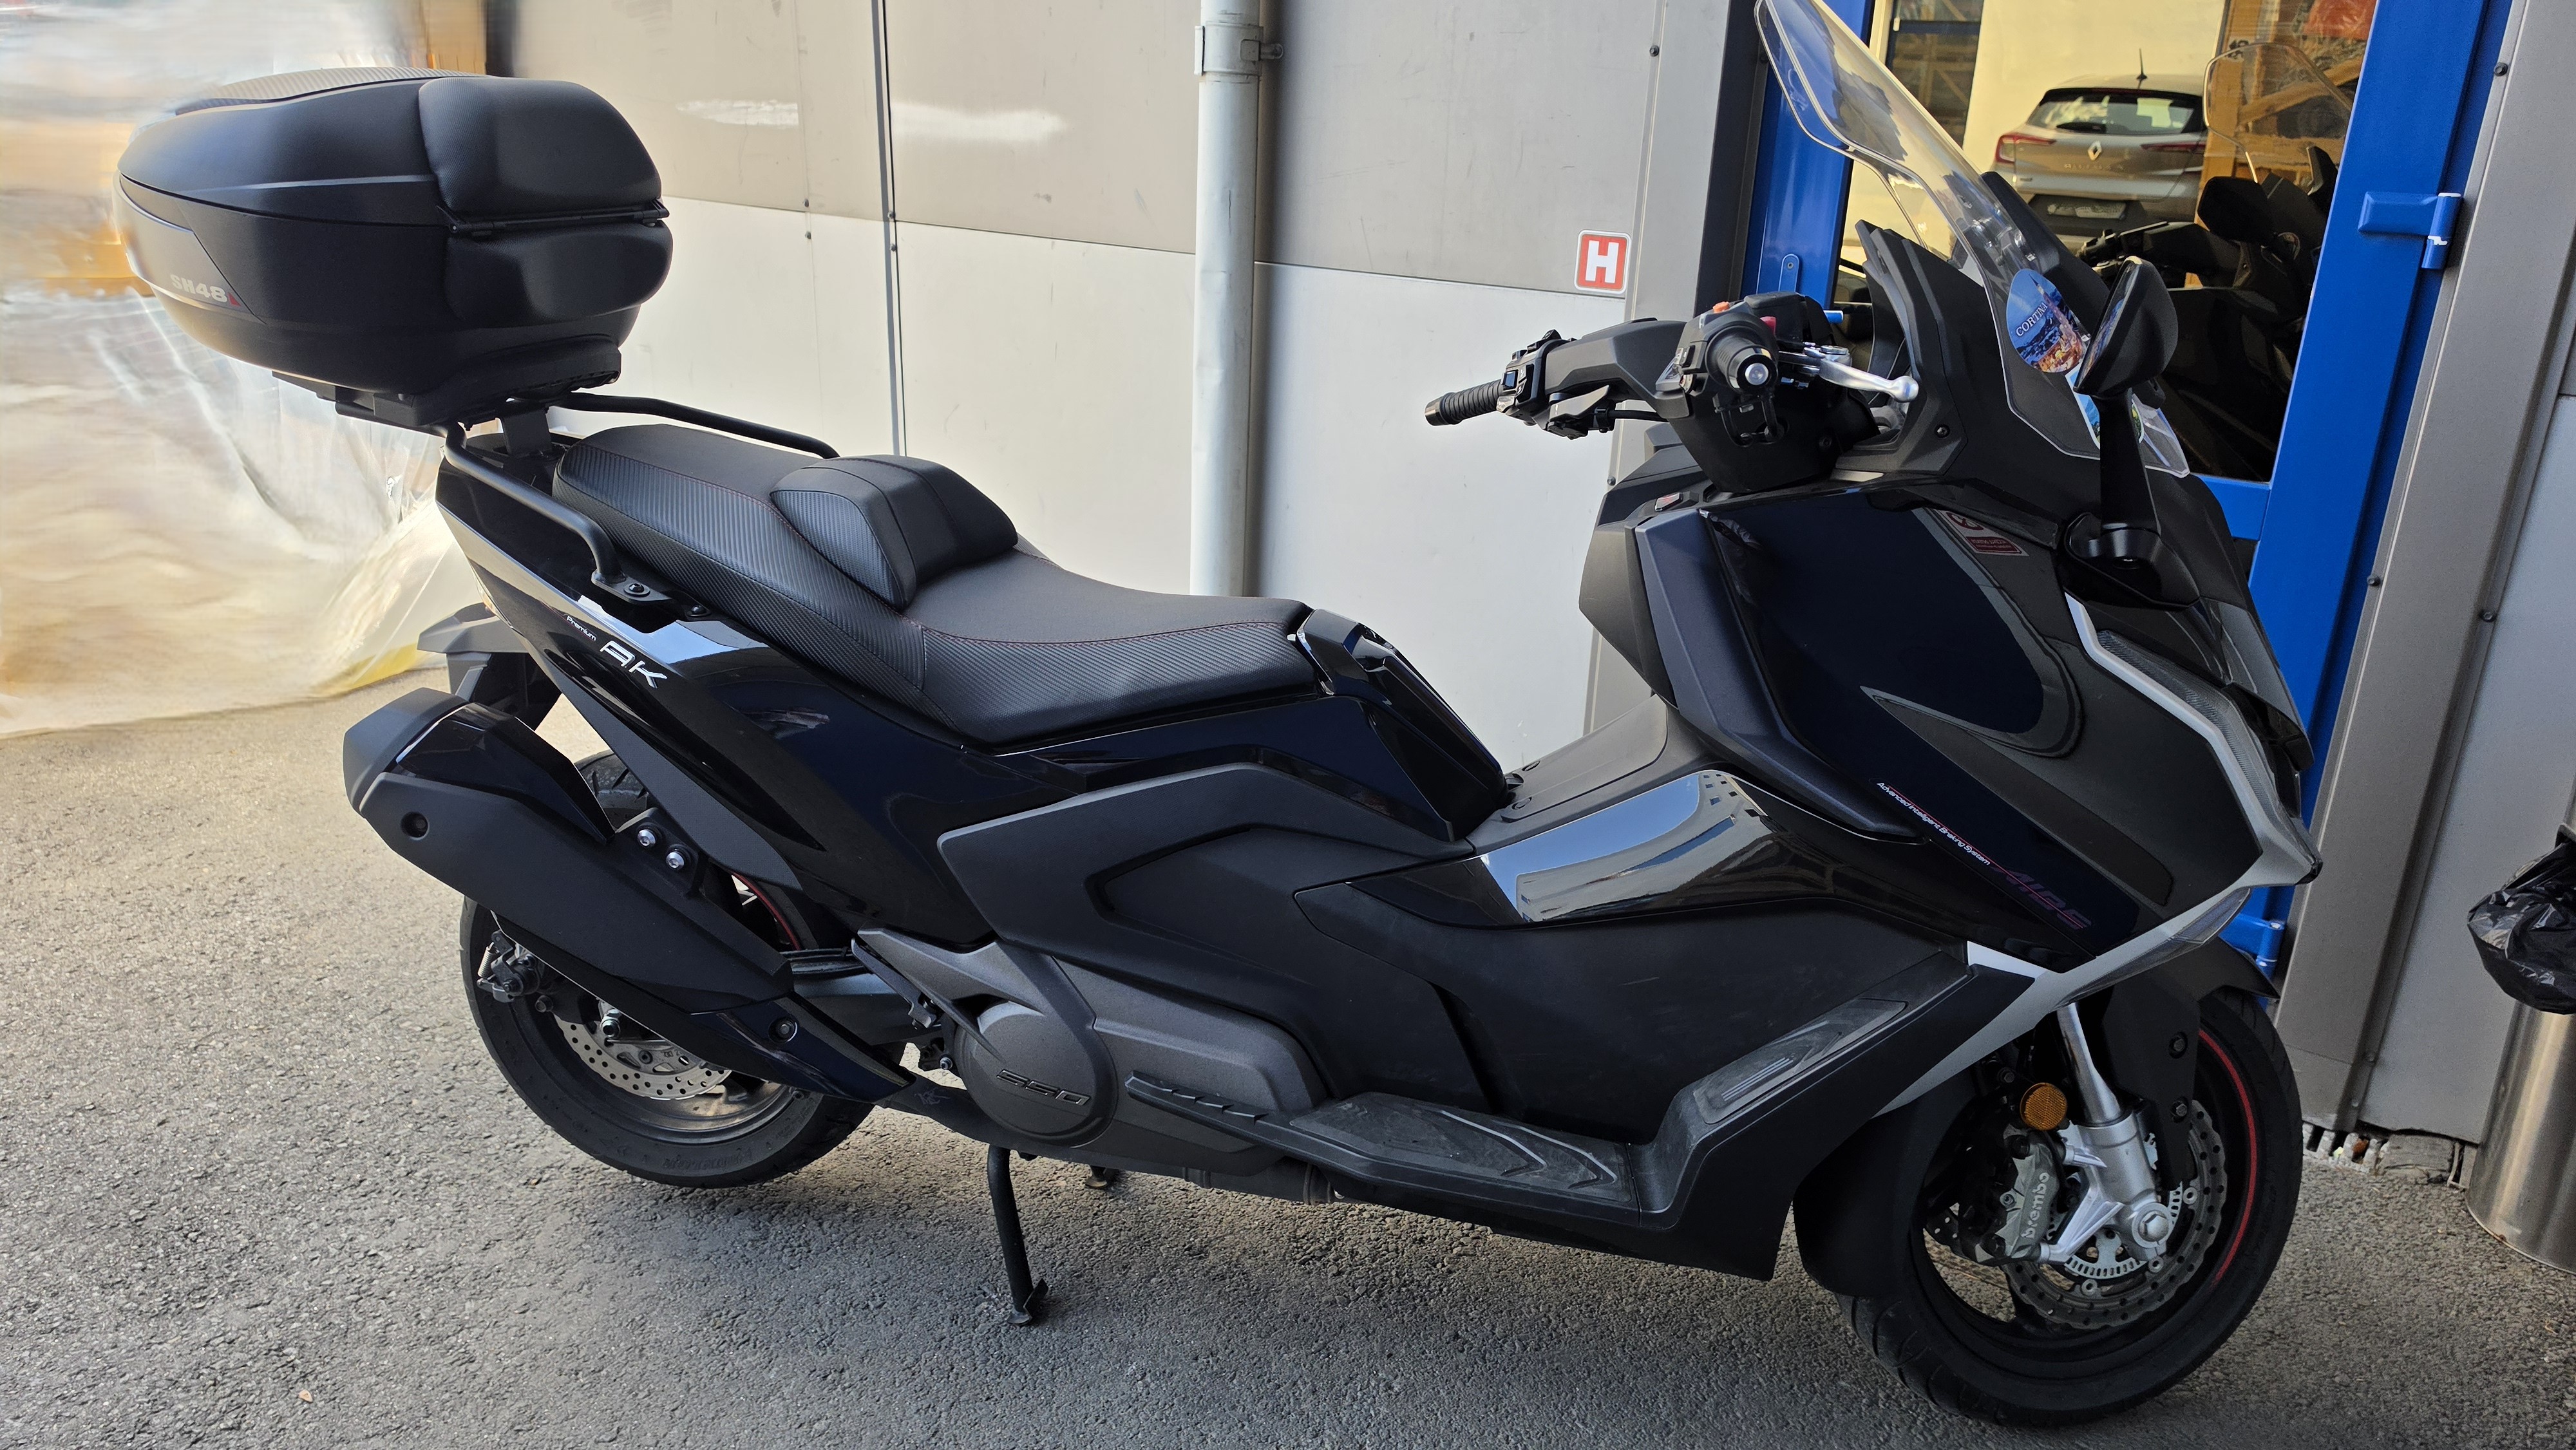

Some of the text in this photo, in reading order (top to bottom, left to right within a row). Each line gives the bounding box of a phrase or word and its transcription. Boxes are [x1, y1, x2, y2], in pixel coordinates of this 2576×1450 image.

[1586, 240, 1619, 283] H
[170, 274, 227, 303] SH48
[2016, 301, 2048, 337] CORTINA
[566, 616, 597, 641] Premium
[600, 640, 668, 688] AK
[1876, 782, 1991, 865] Advanced Intelligent Braking System
[2020, 1172, 2050, 1239] brembo
